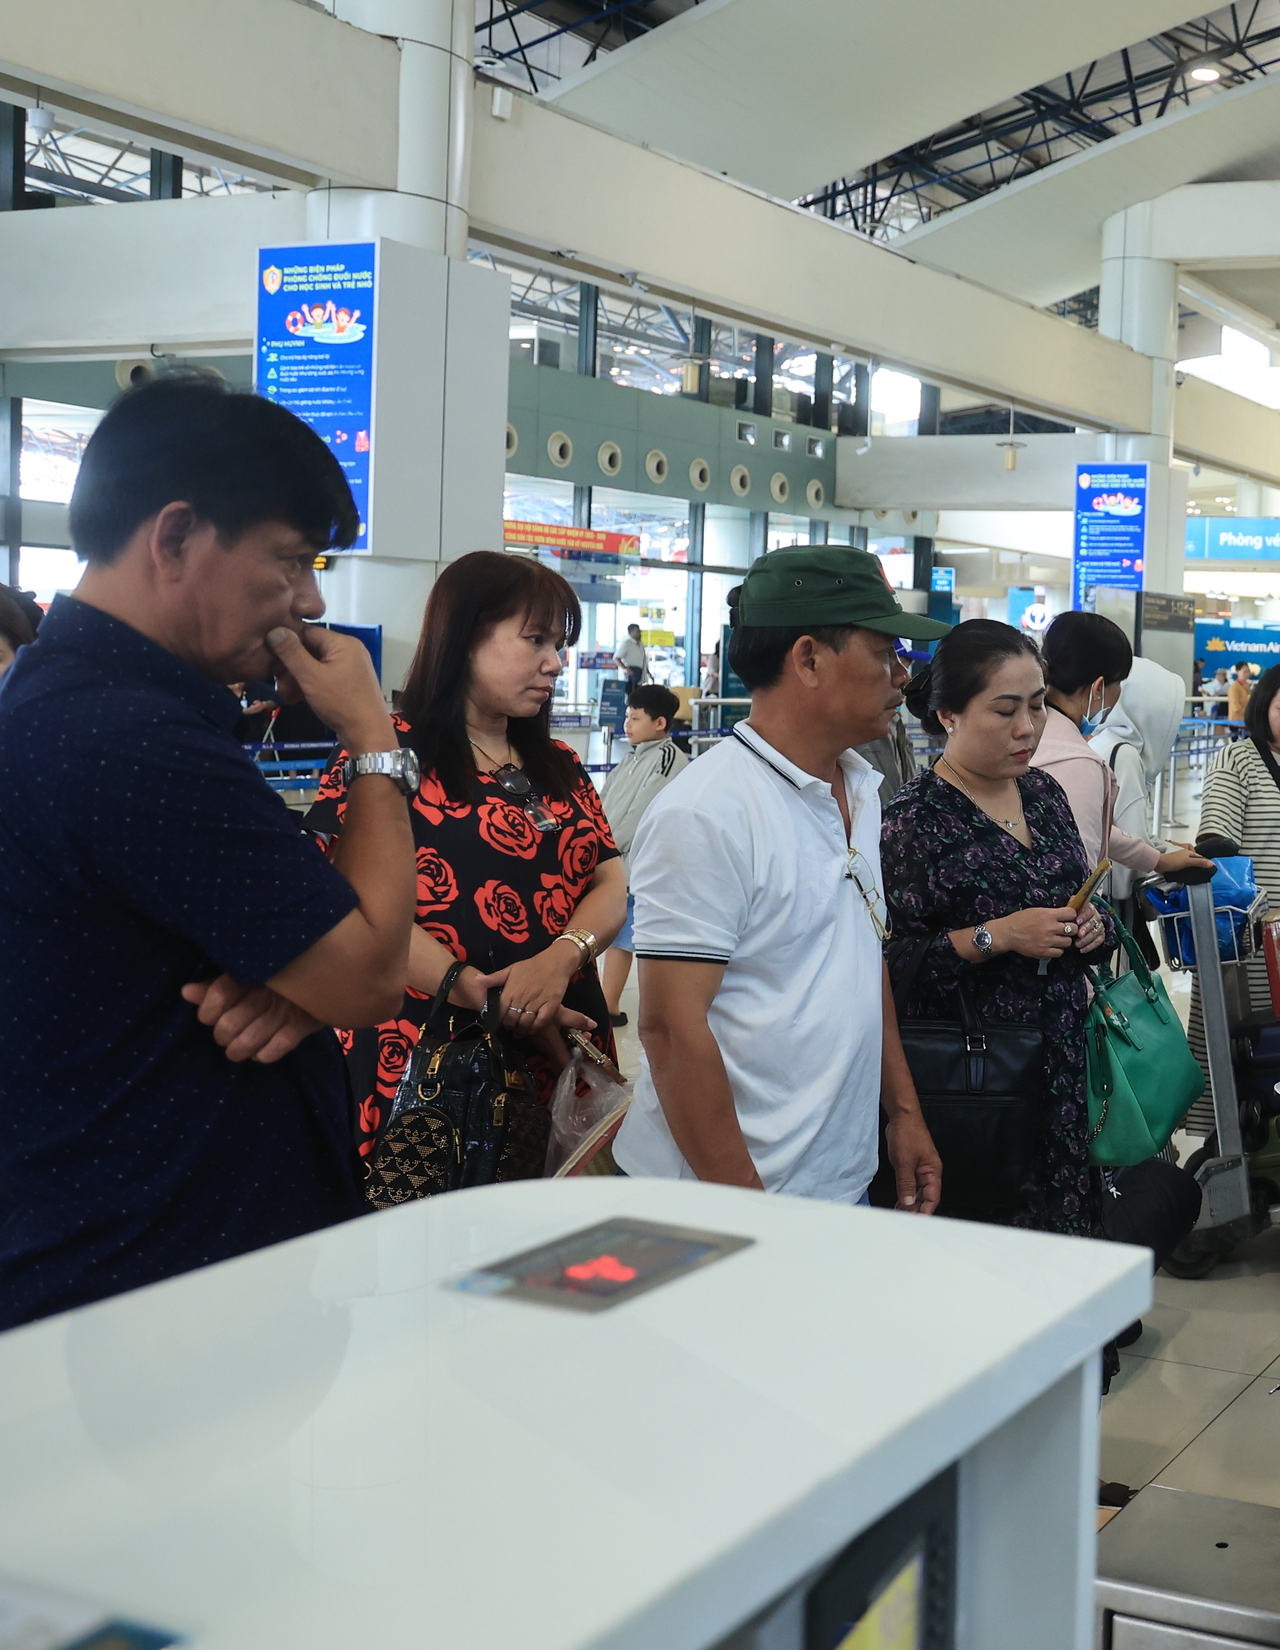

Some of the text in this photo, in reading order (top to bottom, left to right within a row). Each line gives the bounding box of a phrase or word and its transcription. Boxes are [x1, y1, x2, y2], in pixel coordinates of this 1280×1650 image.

[283, 284, 298, 292] CHO
[1219, 532, 1263, 550] Phòng
[1225, 640, 1267, 652] Vietnam
